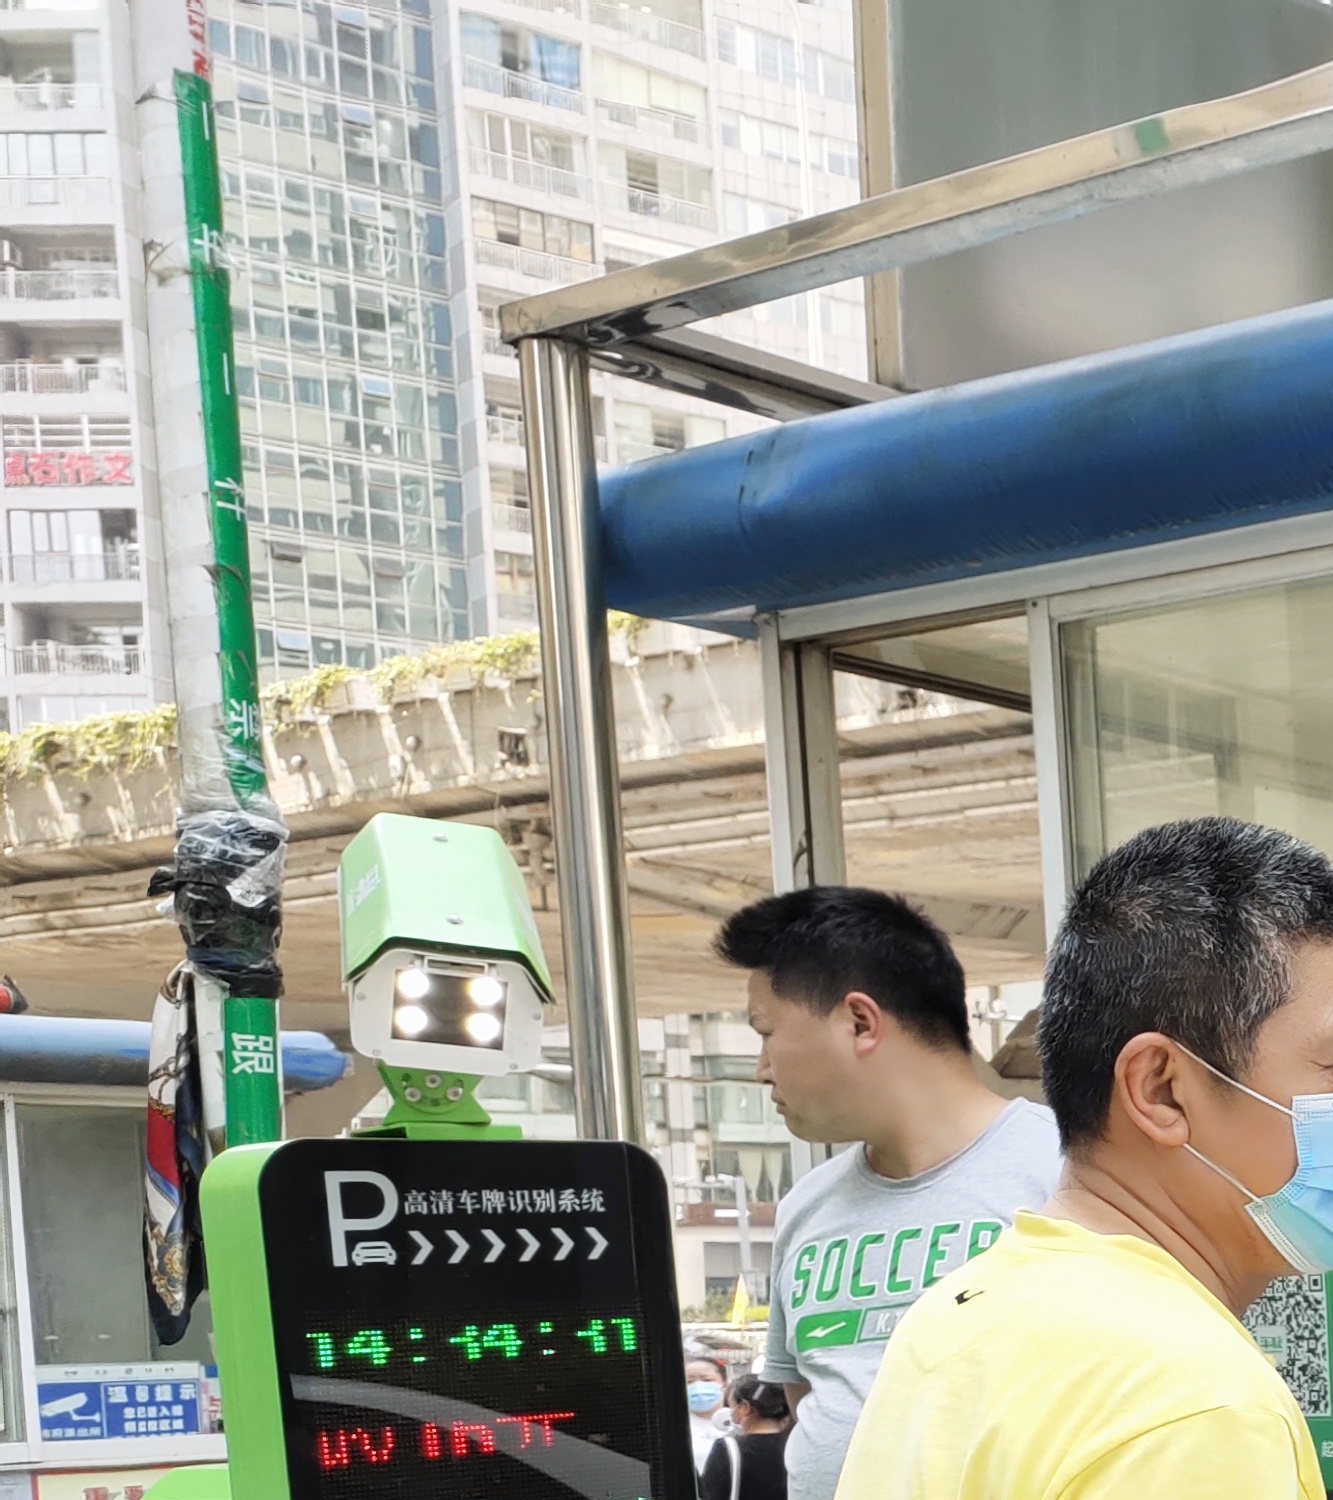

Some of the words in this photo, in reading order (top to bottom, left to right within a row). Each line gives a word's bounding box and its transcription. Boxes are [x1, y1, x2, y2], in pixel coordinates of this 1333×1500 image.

[324, 1171, 399, 1267] P
[403, 1188, 606, 1216] 高清车牌识别系统
